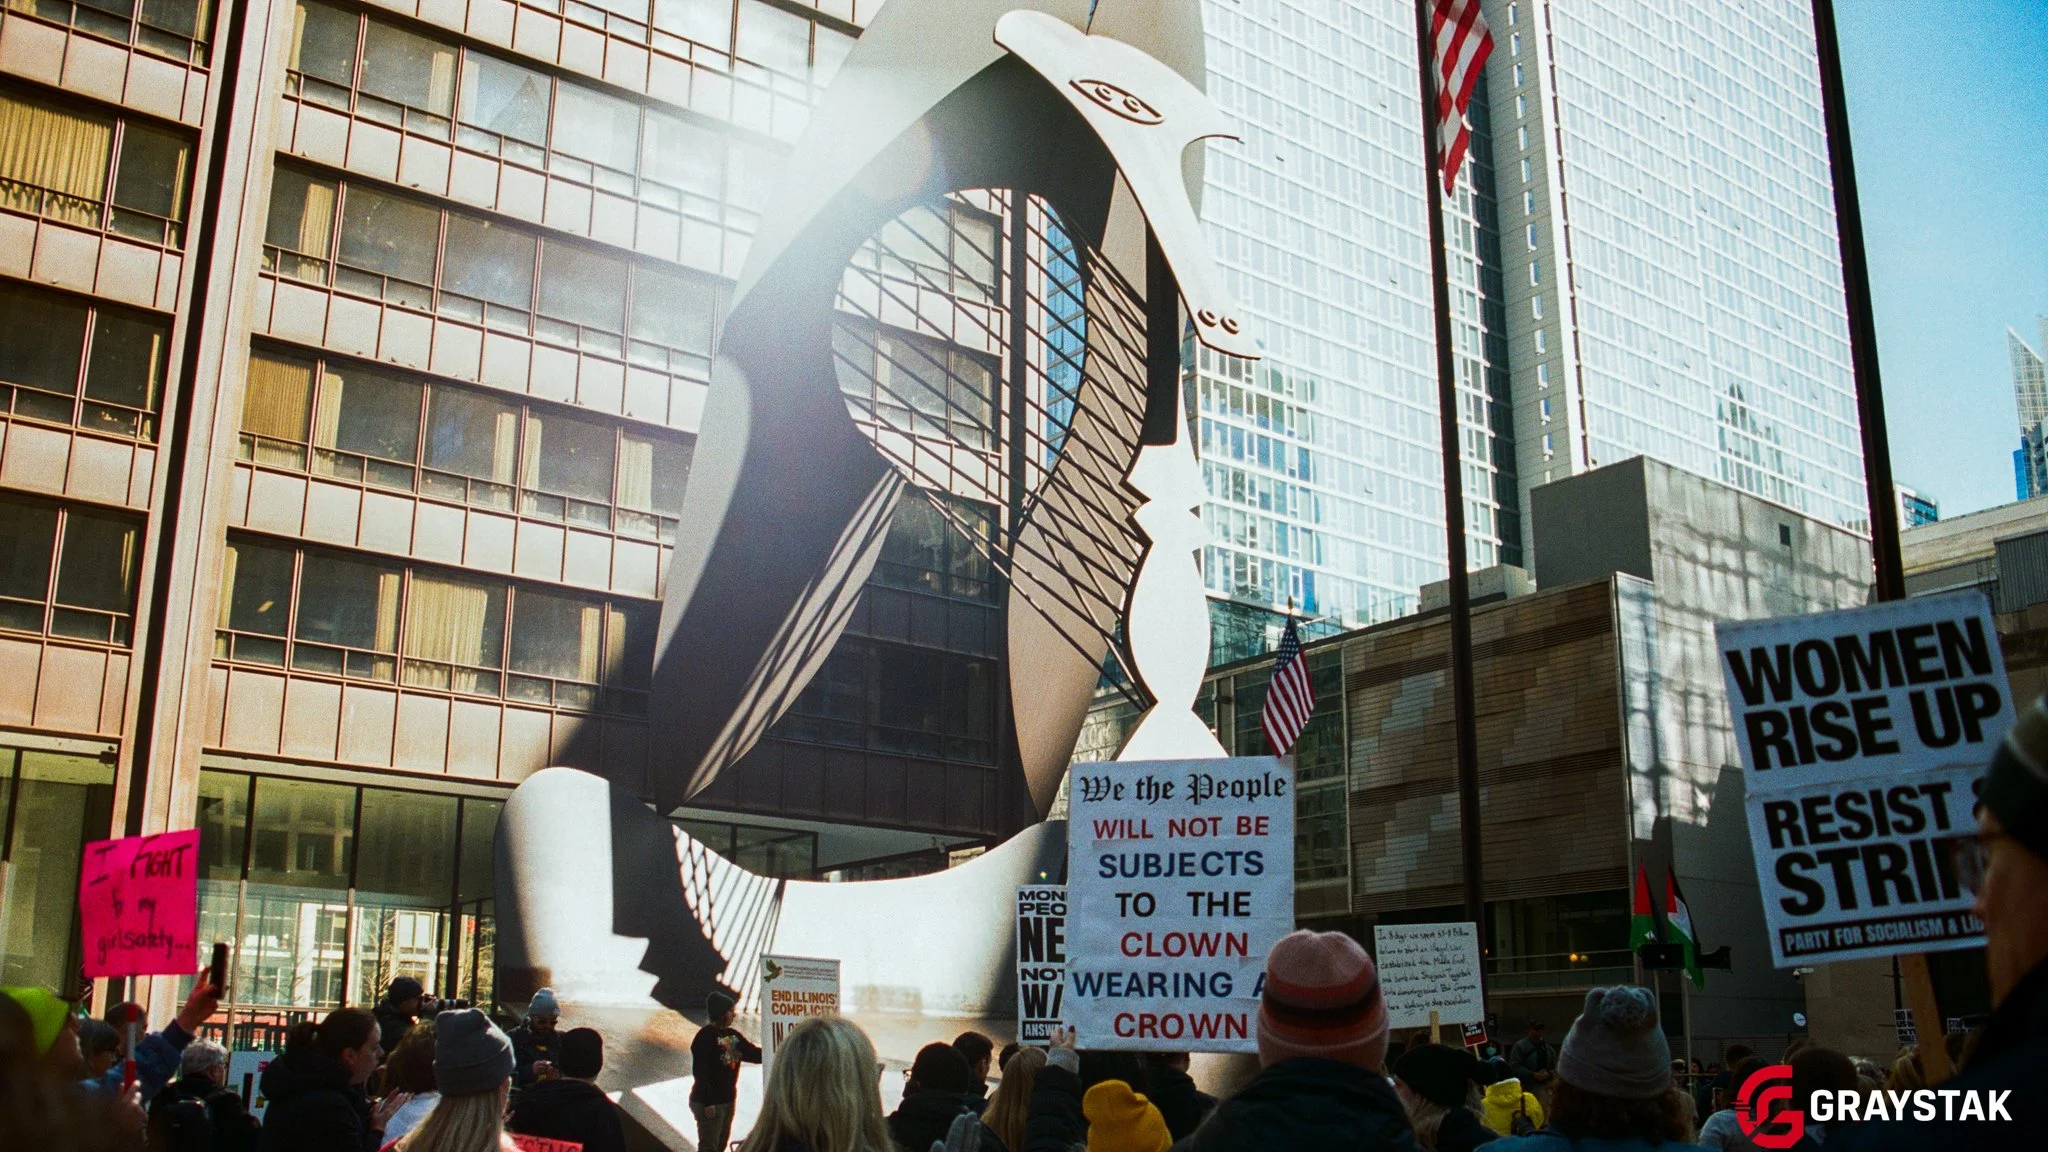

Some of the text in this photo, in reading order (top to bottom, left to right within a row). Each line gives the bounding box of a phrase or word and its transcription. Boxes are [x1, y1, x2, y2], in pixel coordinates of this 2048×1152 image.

[1725, 616, 1993, 707] WOMEN
[1744, 682, 2002, 772] RISE UP
[1079, 771, 1287, 805] We the People
[1093, 816, 1269, 840] WILL NOT BE
[1763, 782, 1953, 849] RESIST
[88, 834, 192, 886] I FIGHT
[1099, 851, 1264, 879] SUBJECTS
[1019, 890, 1067, 901] MON
[1019, 903, 1067, 916] PEO
[1115, 892, 1251, 917] TO THE
[1020, 917, 1066, 963] NE
[1120, 931, 1248, 957] CLOWN
[1785, 914, 1985, 952] PARTY FOR SOCIALISM & LIB
[771, 990, 838, 1005] END ILLINOIS'
[1072, 972, 1232, 998] WEARING
[1022, 984, 1064, 1019] W
[1025, 1024, 1059, 1037] ANSW
[1114, 1012, 1248, 1040] CROWN
